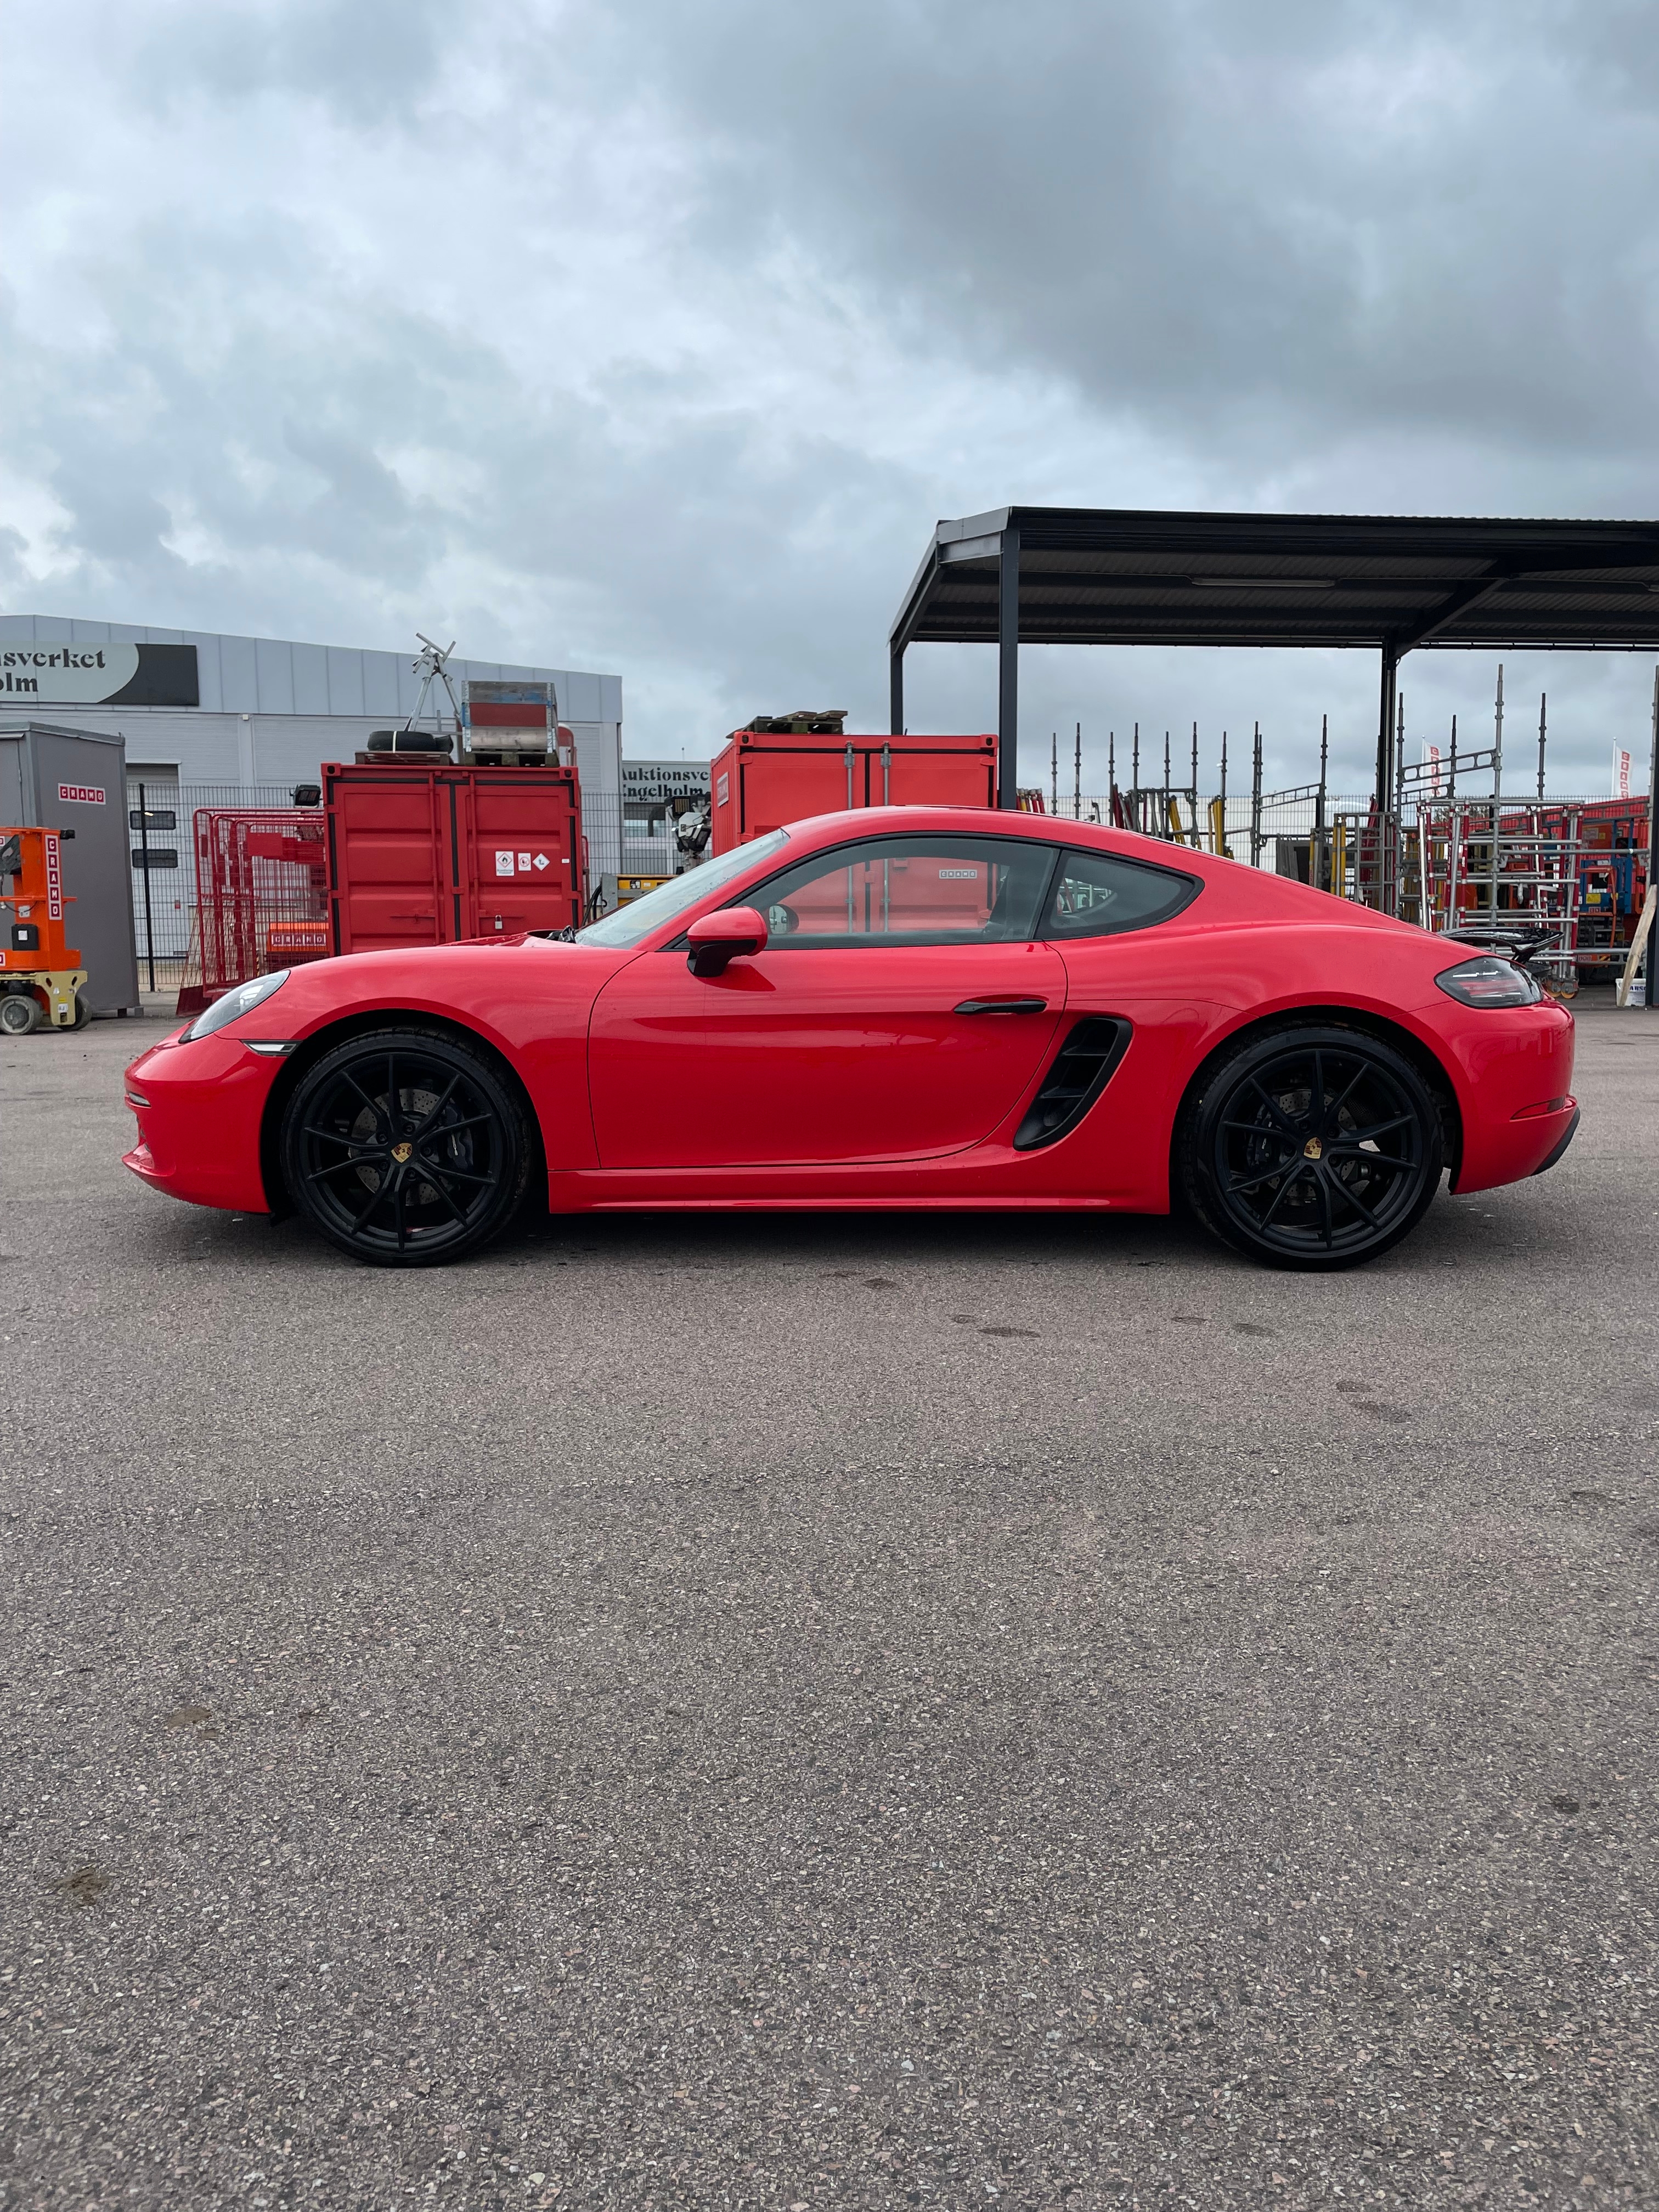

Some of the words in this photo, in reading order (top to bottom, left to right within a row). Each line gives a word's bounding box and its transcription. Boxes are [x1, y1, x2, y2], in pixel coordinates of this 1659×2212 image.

[0, 648, 106, 668] sverket
[622, 767, 712, 781] uktionsve
[61, 788, 103, 801] CRAMO
[623, 785, 703, 802] ngelholm
[49, 840, 59, 915] CRAMO
